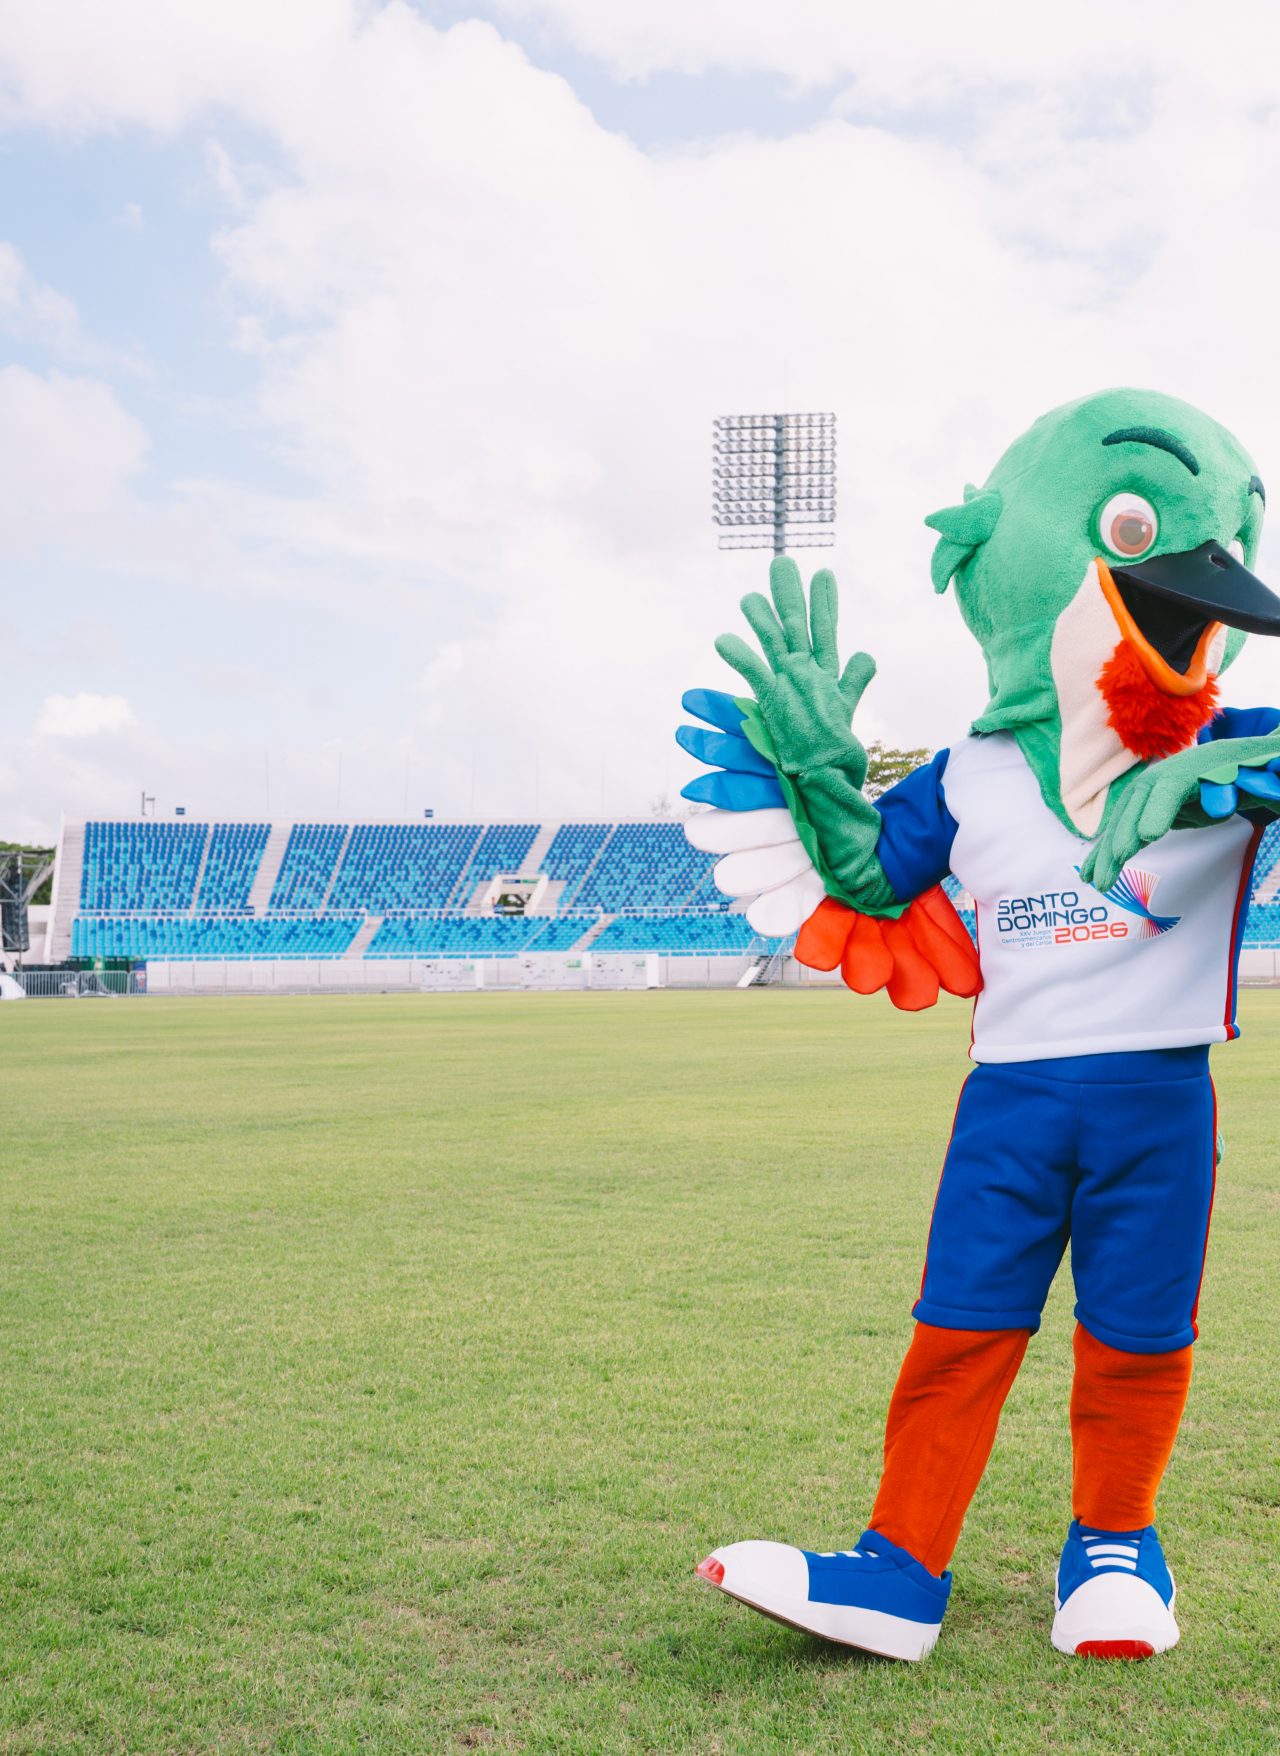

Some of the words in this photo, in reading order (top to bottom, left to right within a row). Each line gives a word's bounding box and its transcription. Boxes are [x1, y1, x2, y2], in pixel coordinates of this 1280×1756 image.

[997, 892, 1079, 915] SANTO
[997, 907, 1108, 932] DOMINGO
[1055, 922, 1129, 944] 2026
